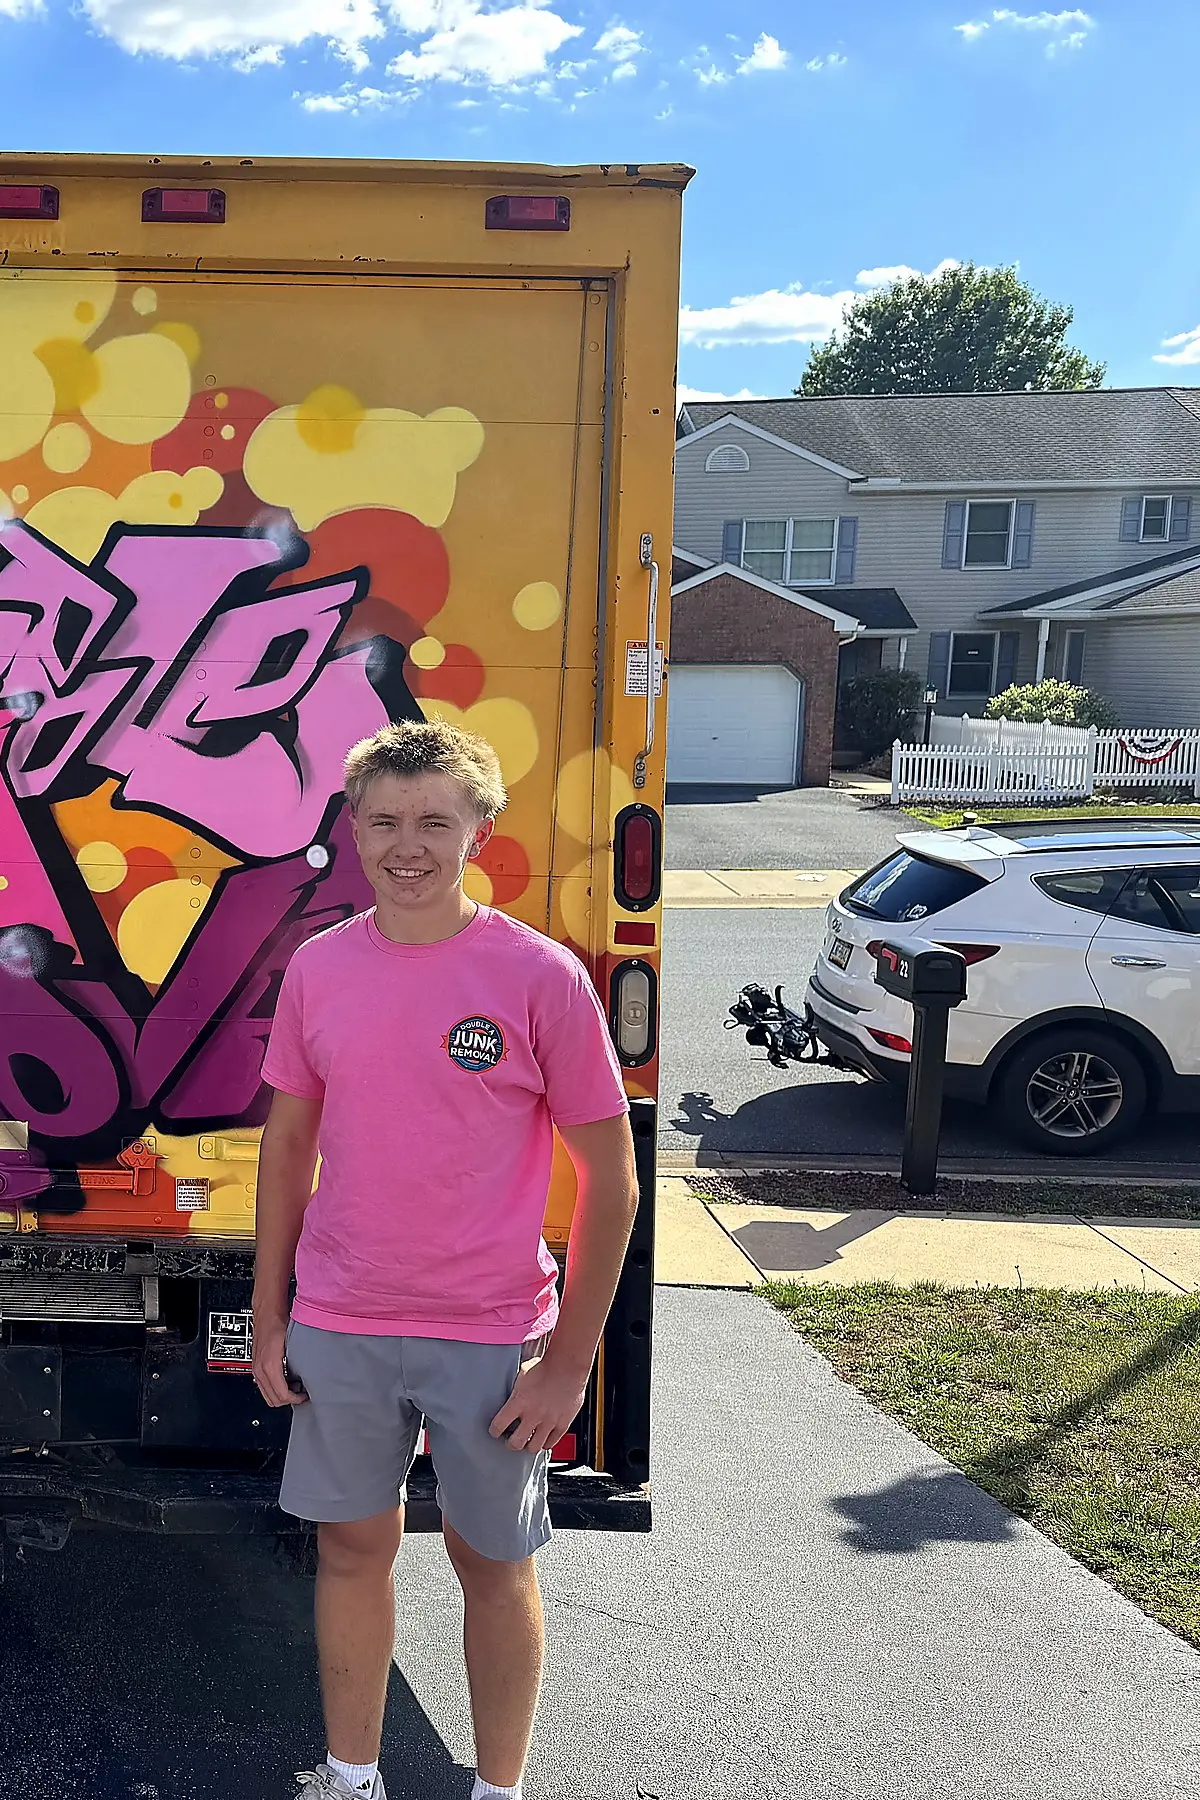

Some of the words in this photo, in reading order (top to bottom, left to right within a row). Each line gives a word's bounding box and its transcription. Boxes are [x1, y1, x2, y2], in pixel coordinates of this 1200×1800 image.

[899, 960, 908, 978] 22
[460, 1021, 490, 1030] DOUBLE
[453, 1030, 497, 1054] JUNK
[450, 1047, 497, 1064] REMOVAL
